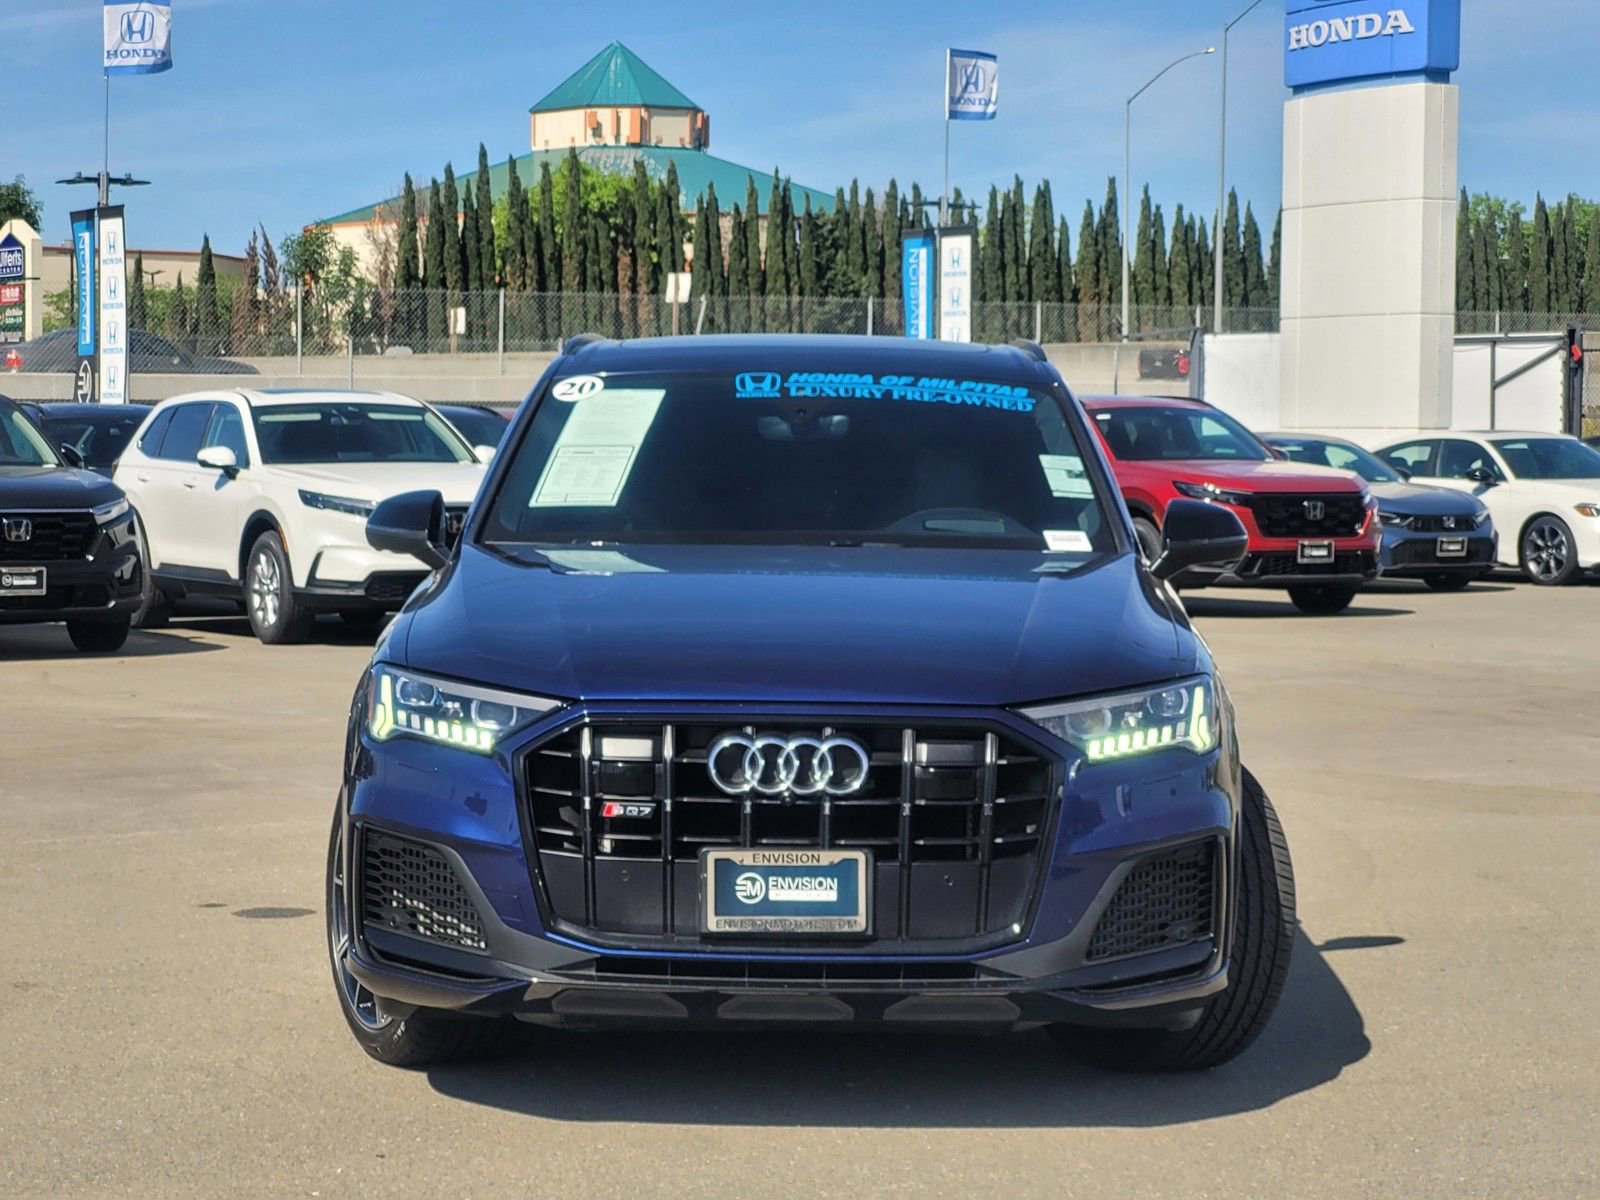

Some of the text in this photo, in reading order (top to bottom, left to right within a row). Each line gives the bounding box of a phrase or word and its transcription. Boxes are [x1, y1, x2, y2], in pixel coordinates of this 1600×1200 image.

[1288, 9, 1415, 50] HONDA
[558, 382, 596, 396] 20
[787, 372, 1029, 397] HONDA OF MILPITAS
[788, 384, 883, 399] LUXURY
[752, 853, 821, 864] ENVISION
[768, 876, 838, 891] ENVISION
